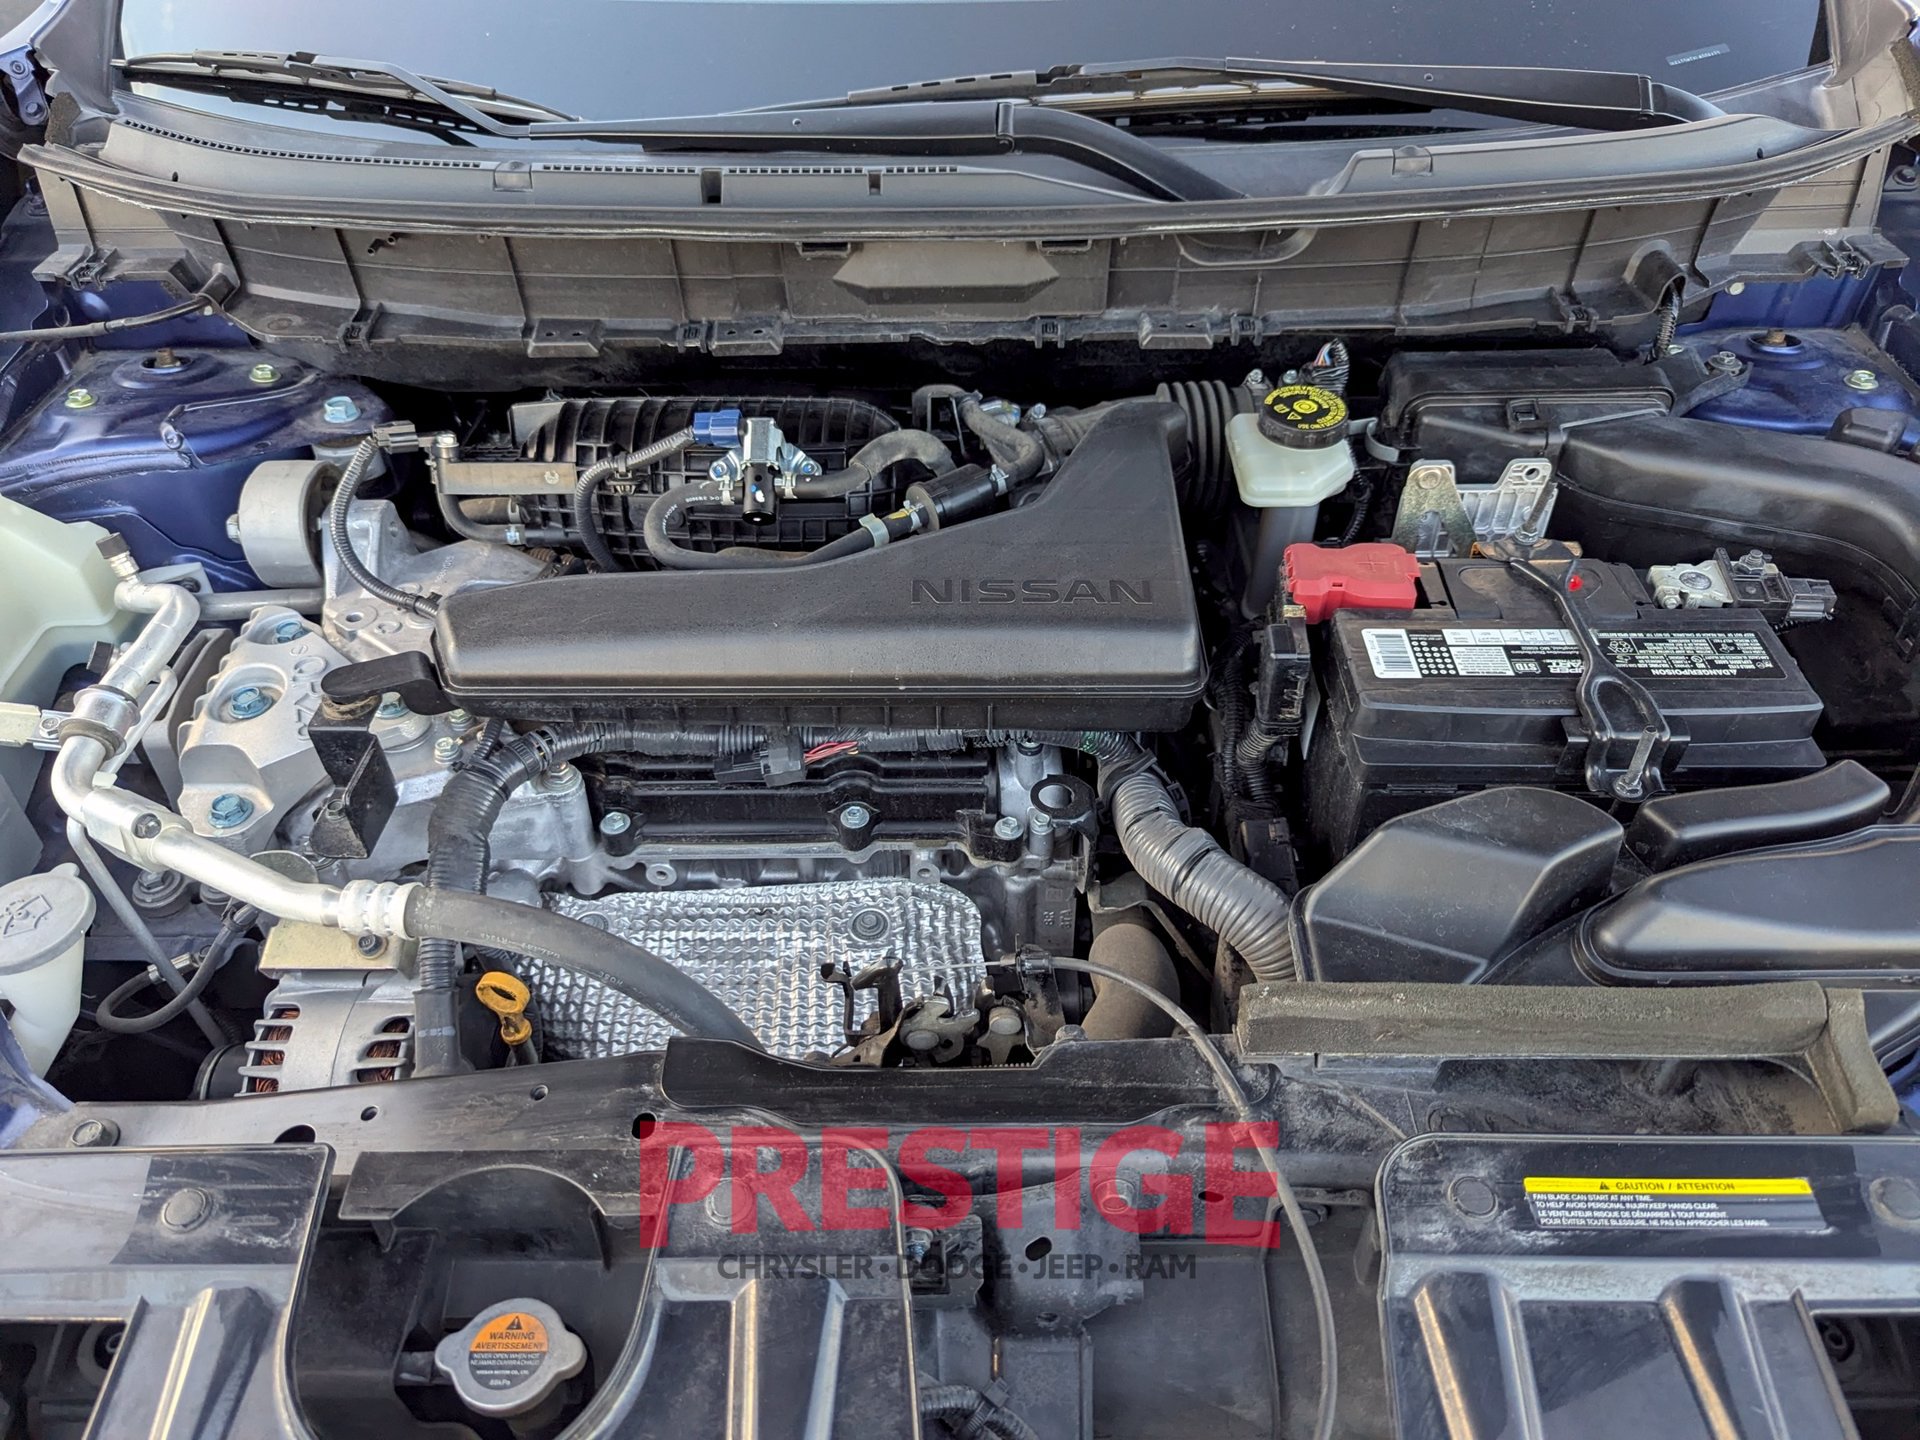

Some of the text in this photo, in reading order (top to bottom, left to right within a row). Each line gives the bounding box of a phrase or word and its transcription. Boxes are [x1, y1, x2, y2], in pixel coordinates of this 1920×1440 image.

[911, 579, 1152, 604] NISSAN
[1616, 1182, 1665, 1191] CAUTION
[1676, 1182, 1736, 1191] ATTENTION
[1532, 1193, 1547, 1201] FAN
[1548, 1193, 1570, 1201] BLADE
[1536, 1201, 1546, 1209] TO
[1546, 1201, 1564, 1209] HELP
[1594, 1210, 1620, 1218] RISQUE
[1621, 1210, 1630, 1218] DE
[1586, 1218, 1610, 1226] TOUTE
[489, 1331, 536, 1340] WARNING
[474, 1341, 544, 1350] AVERTISSEMENT
